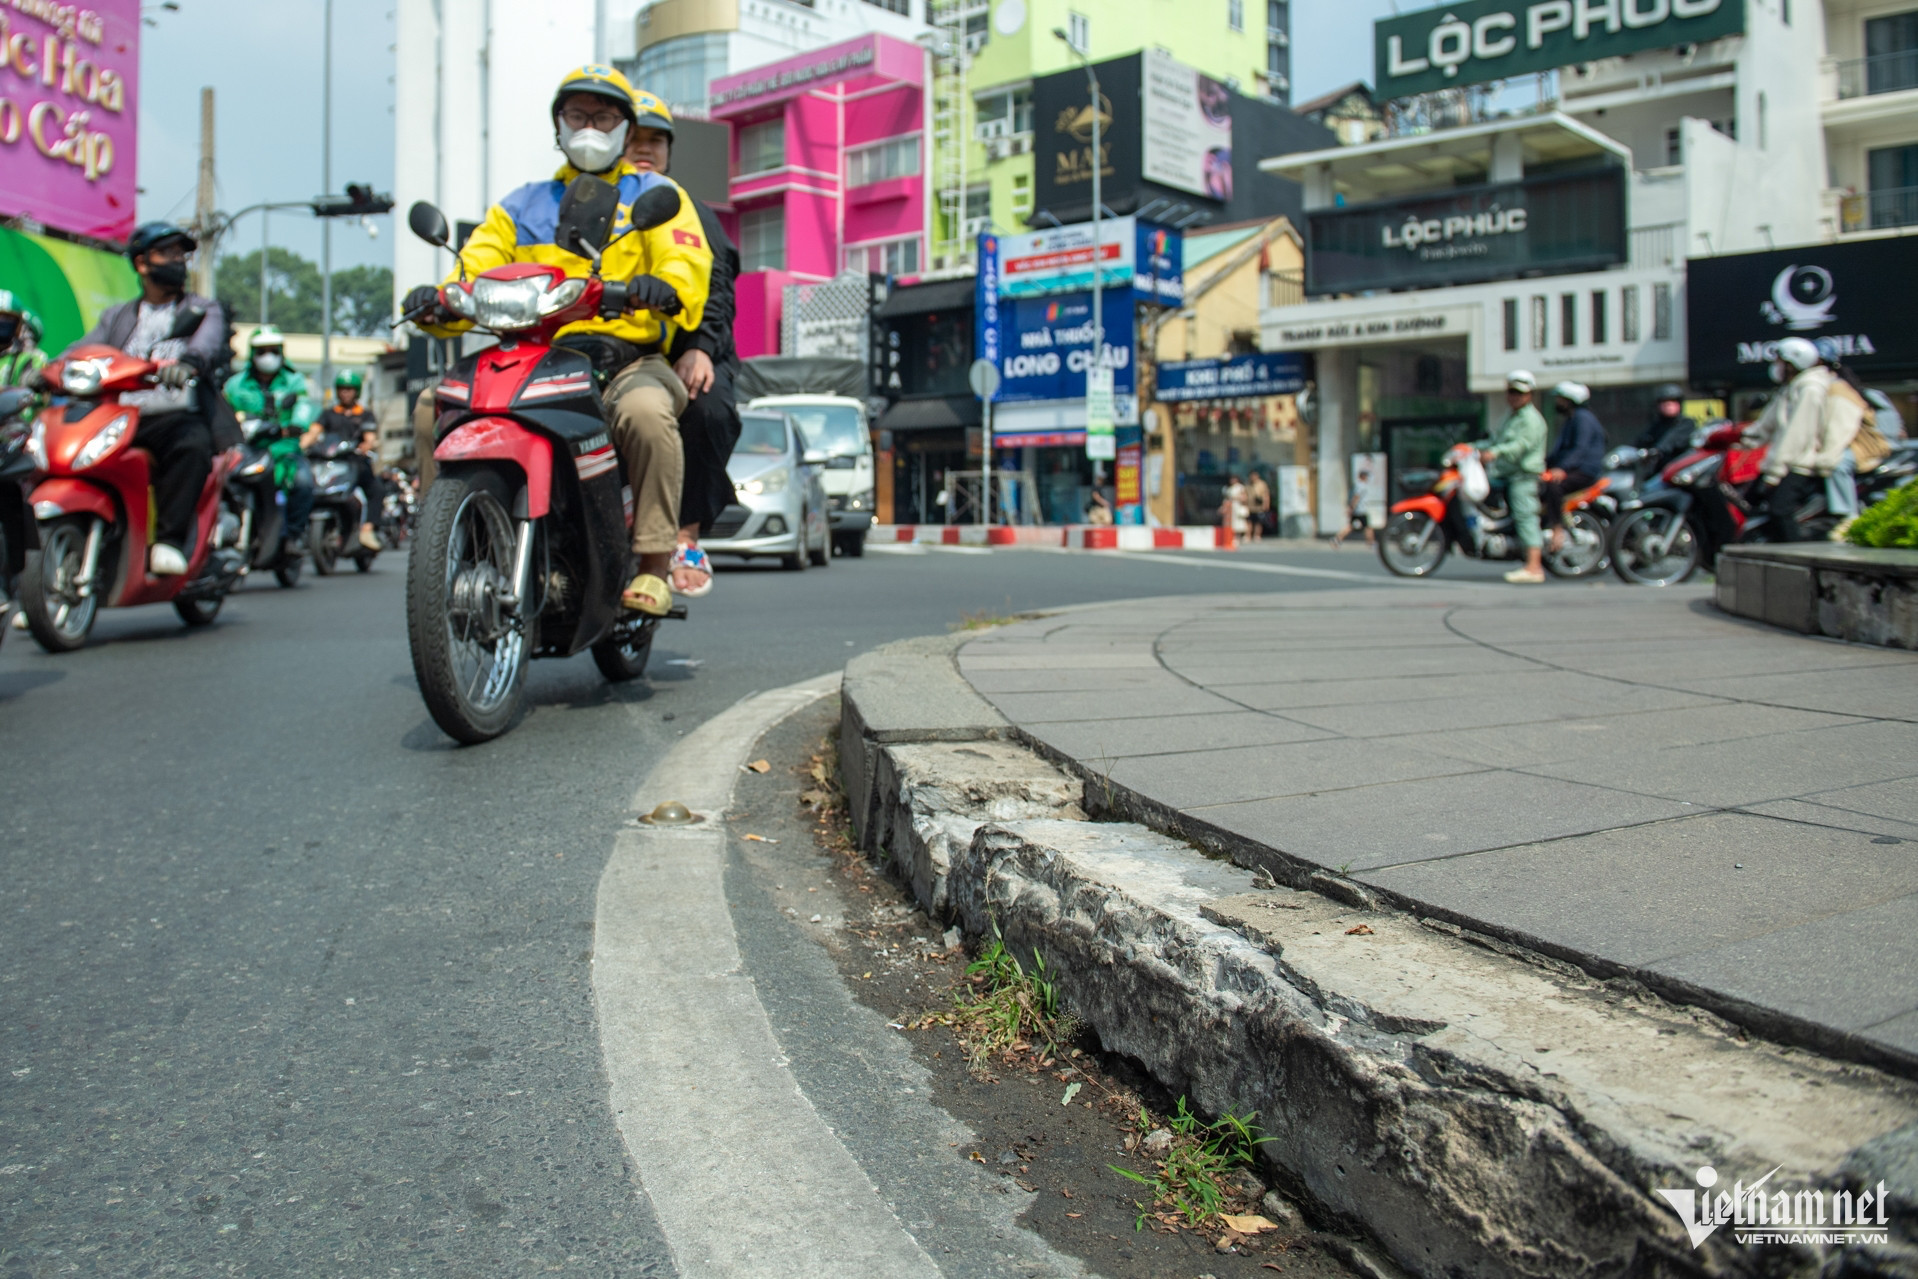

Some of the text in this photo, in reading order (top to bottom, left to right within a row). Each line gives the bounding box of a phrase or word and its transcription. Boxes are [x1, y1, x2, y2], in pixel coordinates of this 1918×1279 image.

[1387, 13, 1516, 77] LỘC
[42, 35, 123, 111] Hoa
[28, 100, 113, 181] Cấp
[1382, 203, 1528, 250] LỘC PHÚC
[888, 331, 902, 389] SPA
[1021, 326, 1053, 348] NHÀ
[1004, 352, 1060, 378] LONG
[578, 432, 609, 455] YAMAHA
